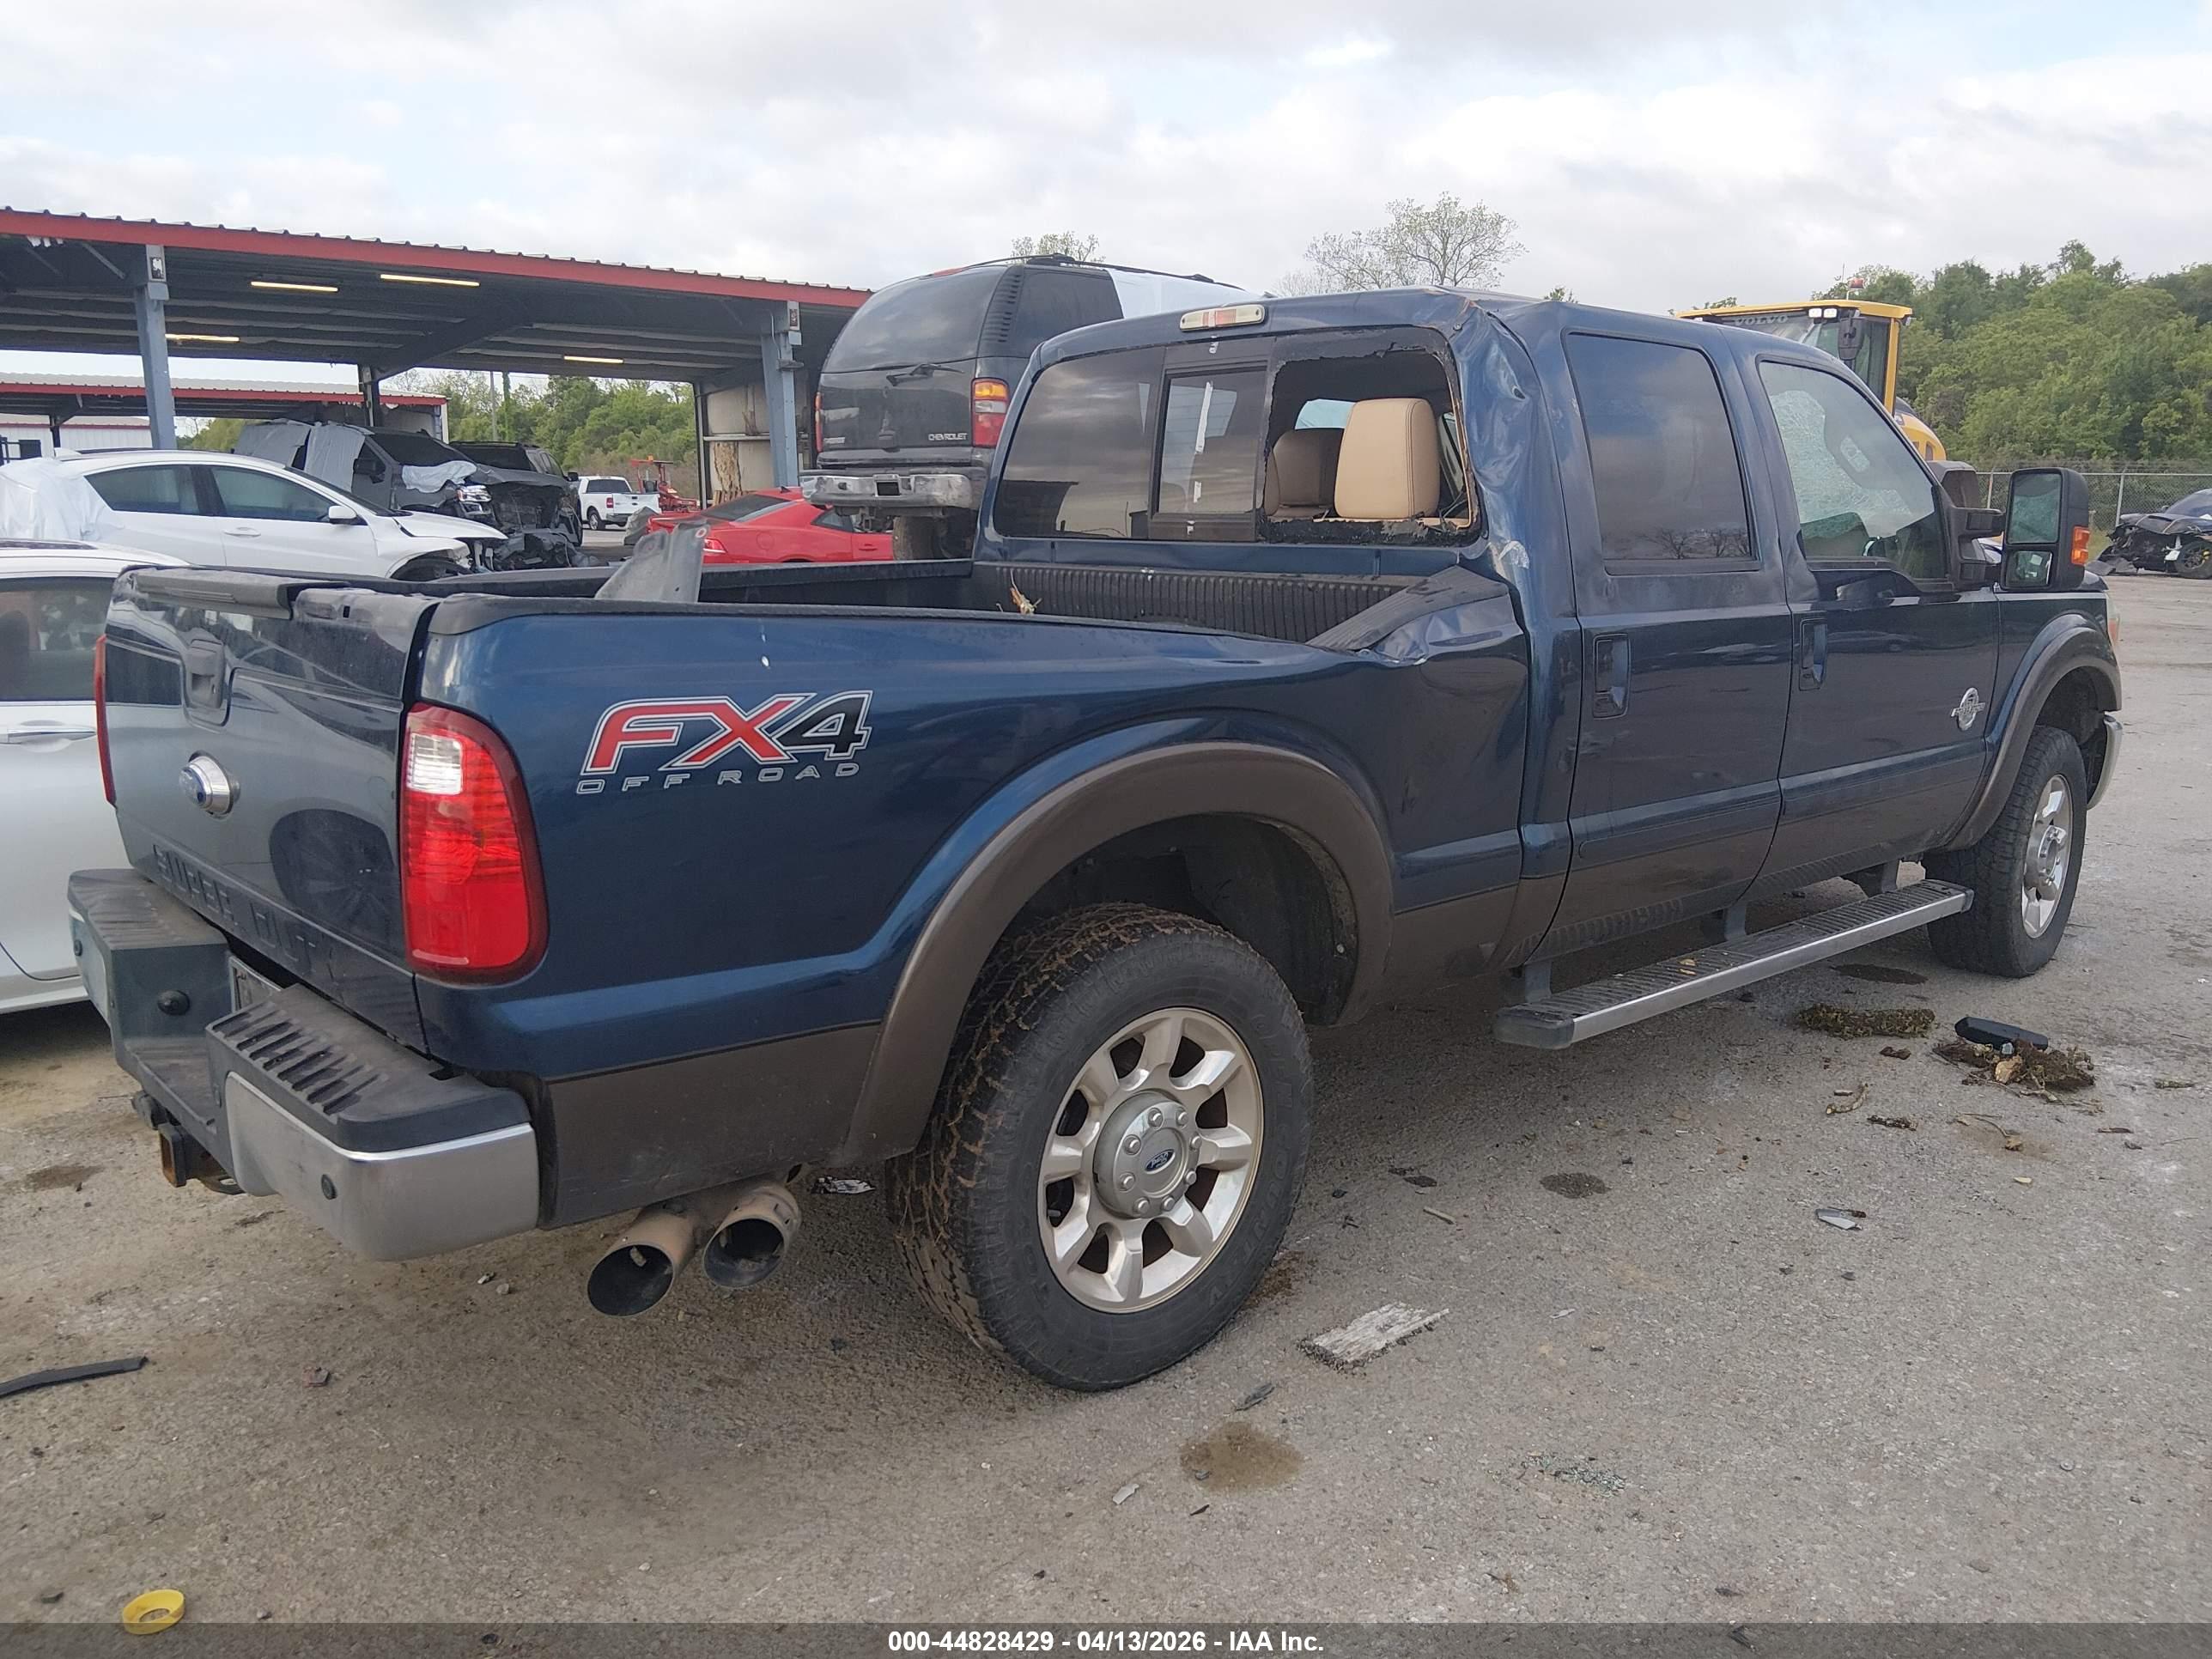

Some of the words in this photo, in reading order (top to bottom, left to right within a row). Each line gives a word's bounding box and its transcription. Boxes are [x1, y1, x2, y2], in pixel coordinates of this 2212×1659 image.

[1735, 315, 1788, 325] VOLVO
[580, 690, 872, 775] FX4
[576, 773, 690, 794] OFF
[717, 763, 860, 785] ROAD
